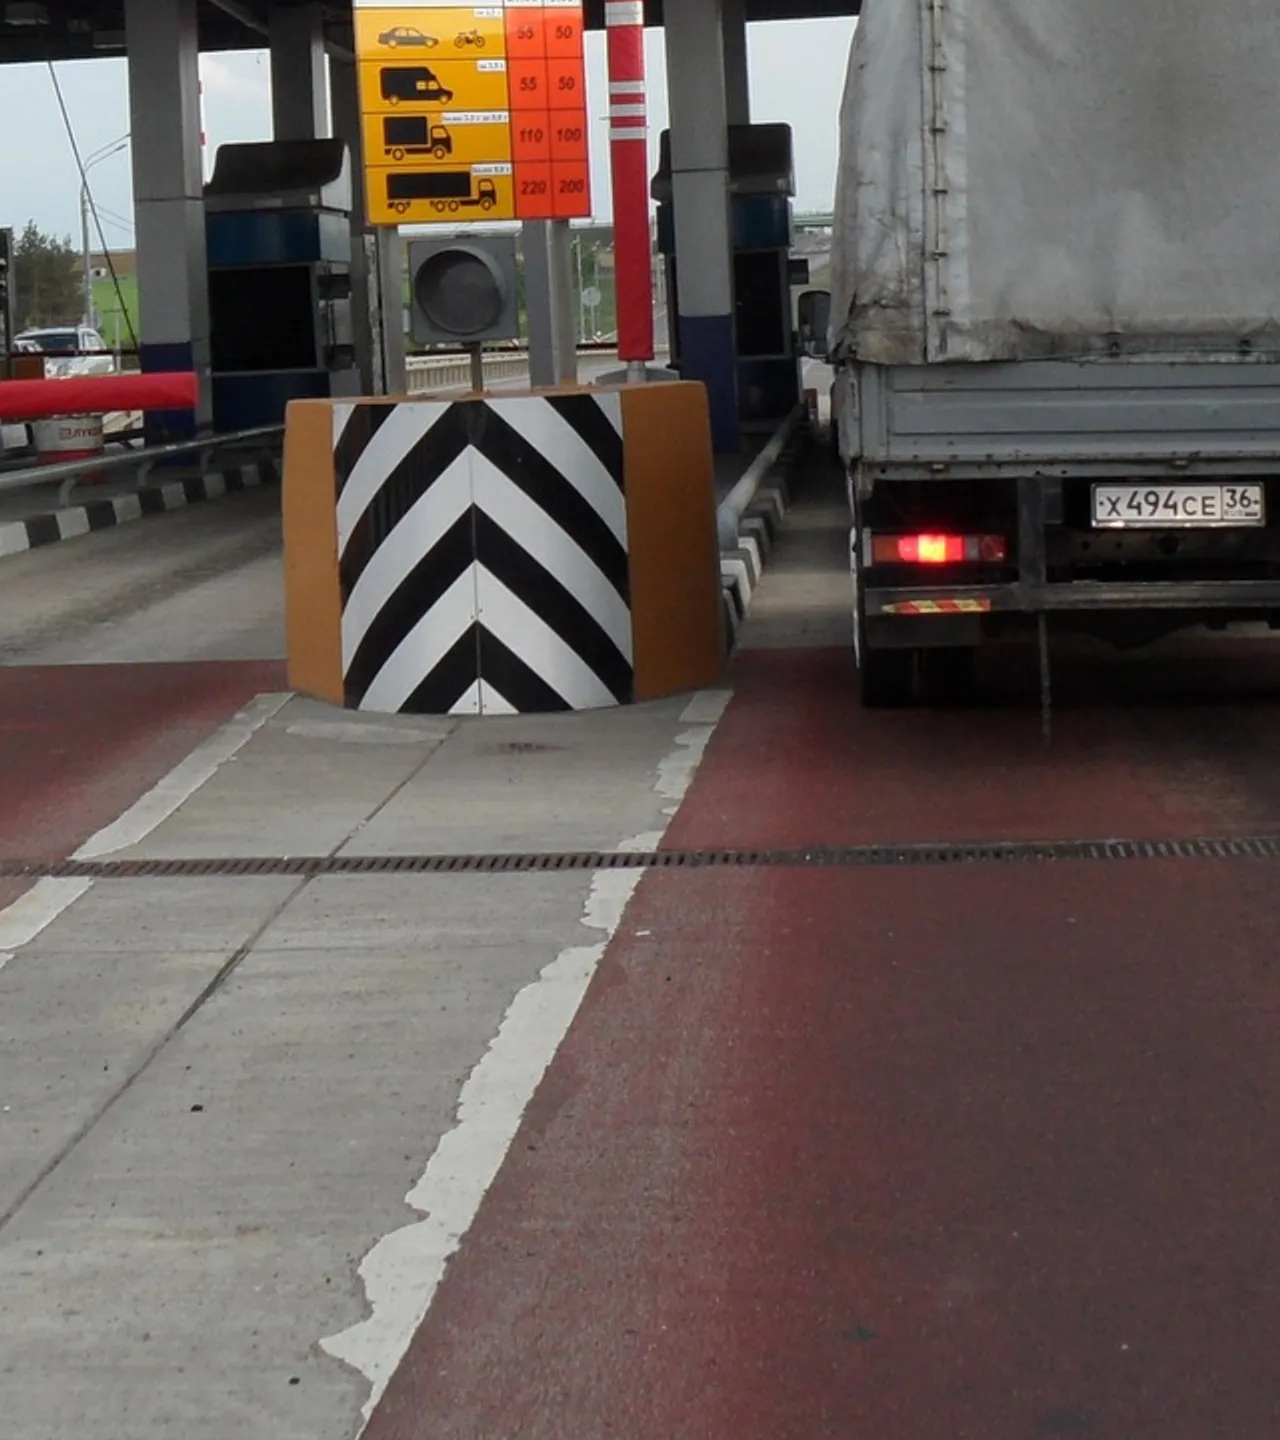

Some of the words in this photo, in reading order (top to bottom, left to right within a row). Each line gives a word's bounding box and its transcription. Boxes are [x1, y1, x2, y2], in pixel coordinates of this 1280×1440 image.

[517, 26, 534, 40] 55
[555, 26, 573, 40] 50
[520, 77, 538, 91] 55
[558, 77, 575, 91] 50
[519, 129, 544, 143] 110
[556, 128, 582, 143] 100
[521, 181, 547, 195] 220
[558, 179, 584, 194] 200
[1225, 488, 1252, 508] 36
